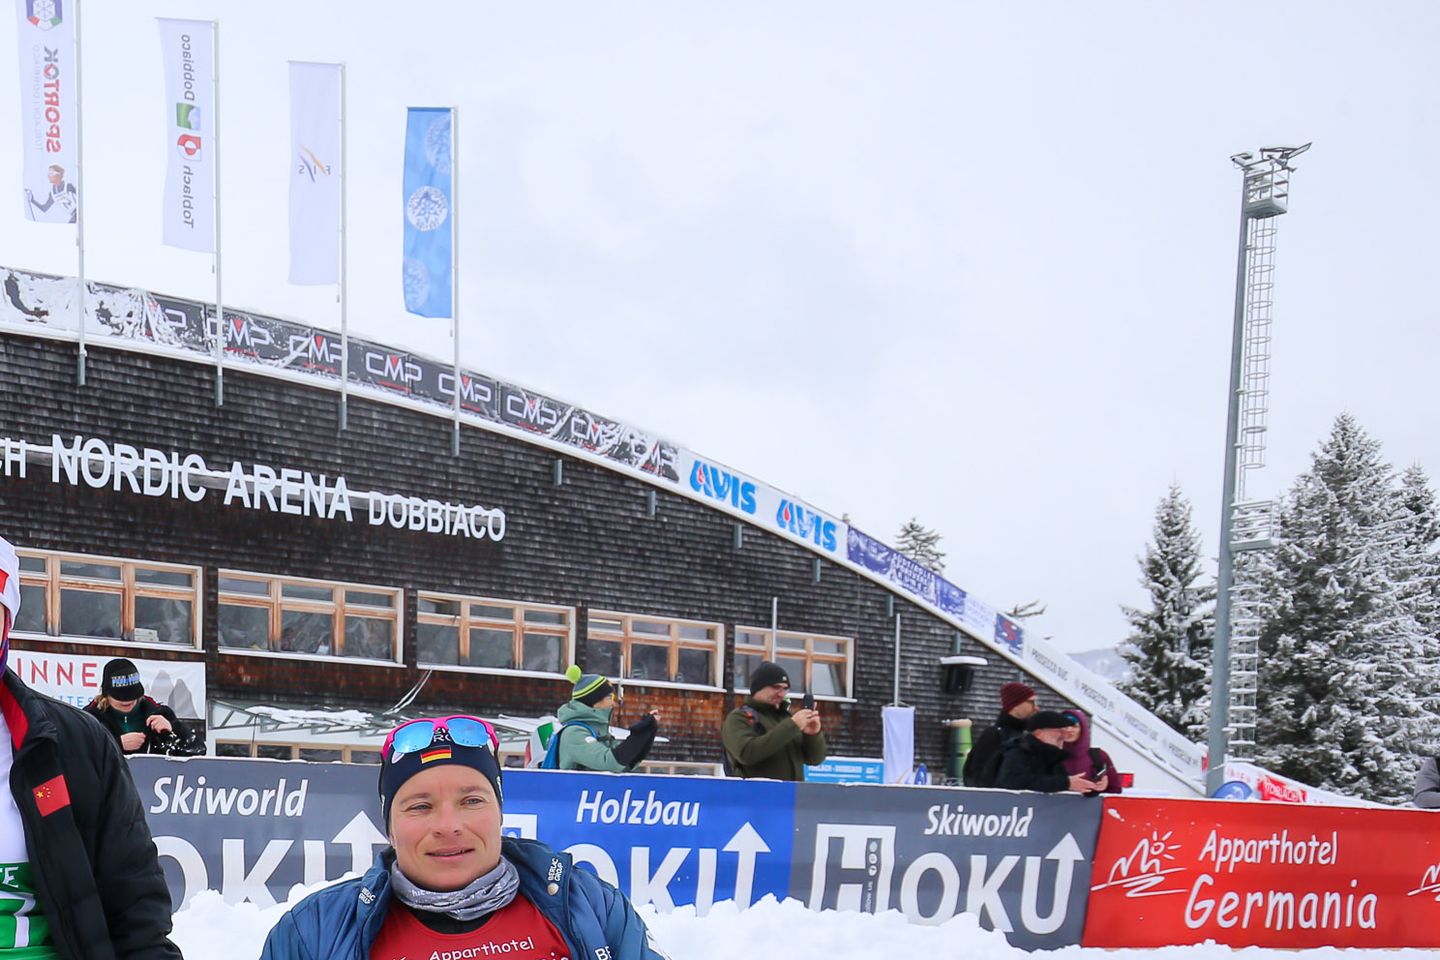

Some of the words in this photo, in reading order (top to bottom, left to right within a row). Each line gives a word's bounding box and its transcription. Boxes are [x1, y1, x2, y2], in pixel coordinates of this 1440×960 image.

[365, 351, 423, 384] CMP
[438, 372, 492, 404] CMP
[506, 394, 558, 426] CMP
[51, 434, 207, 502] NORDIC
[223, 461, 353, 521] ARENA
[368, 491, 506, 542] DOBBIACO
[689, 459, 758, 515] AVIS
[776, 499, 838, 552] AVIS
[17, 658, 98, 688] INNE
[150, 775, 309, 817] Skiworld
[576, 789, 701, 827] Holzbau
[924, 805, 1035, 838] Skiworld
[1198, 829, 1338, 873] Apparthotel
[1184, 873, 1378, 931] Germania
